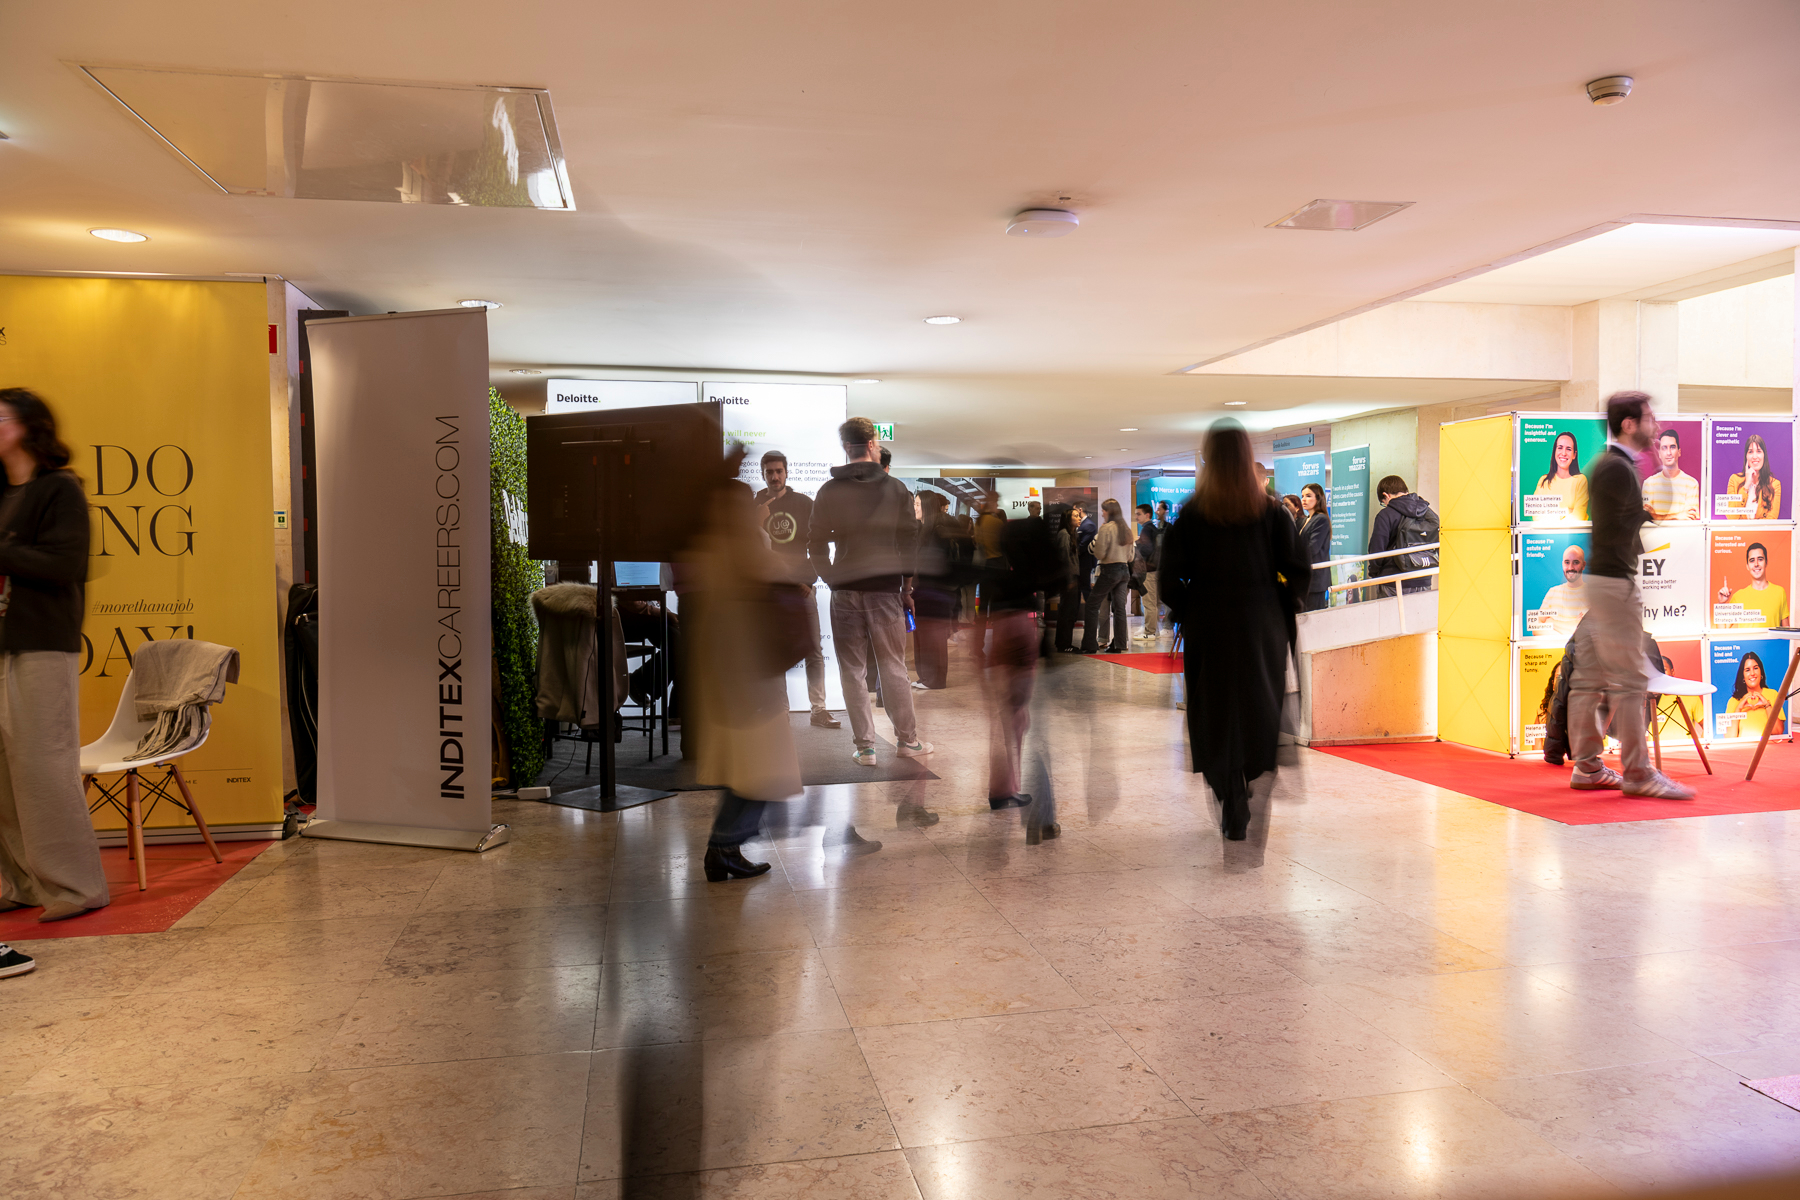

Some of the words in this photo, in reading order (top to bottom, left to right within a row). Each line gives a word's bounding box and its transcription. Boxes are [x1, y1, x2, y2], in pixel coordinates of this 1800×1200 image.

[556, 394, 601, 403] Deloitte.
[89, 444, 194, 497] DO
[1012, 501, 1031, 509] pw
[88, 504, 199, 557] NG
[1643, 559, 1666, 576] EY
[92, 598, 194, 616] #morethanajob
[434, 415, 464, 800] INDITEXCAREERS.COM
[1644, 606, 1658, 620] hy
[1664, 605, 1687, 617] Me?
